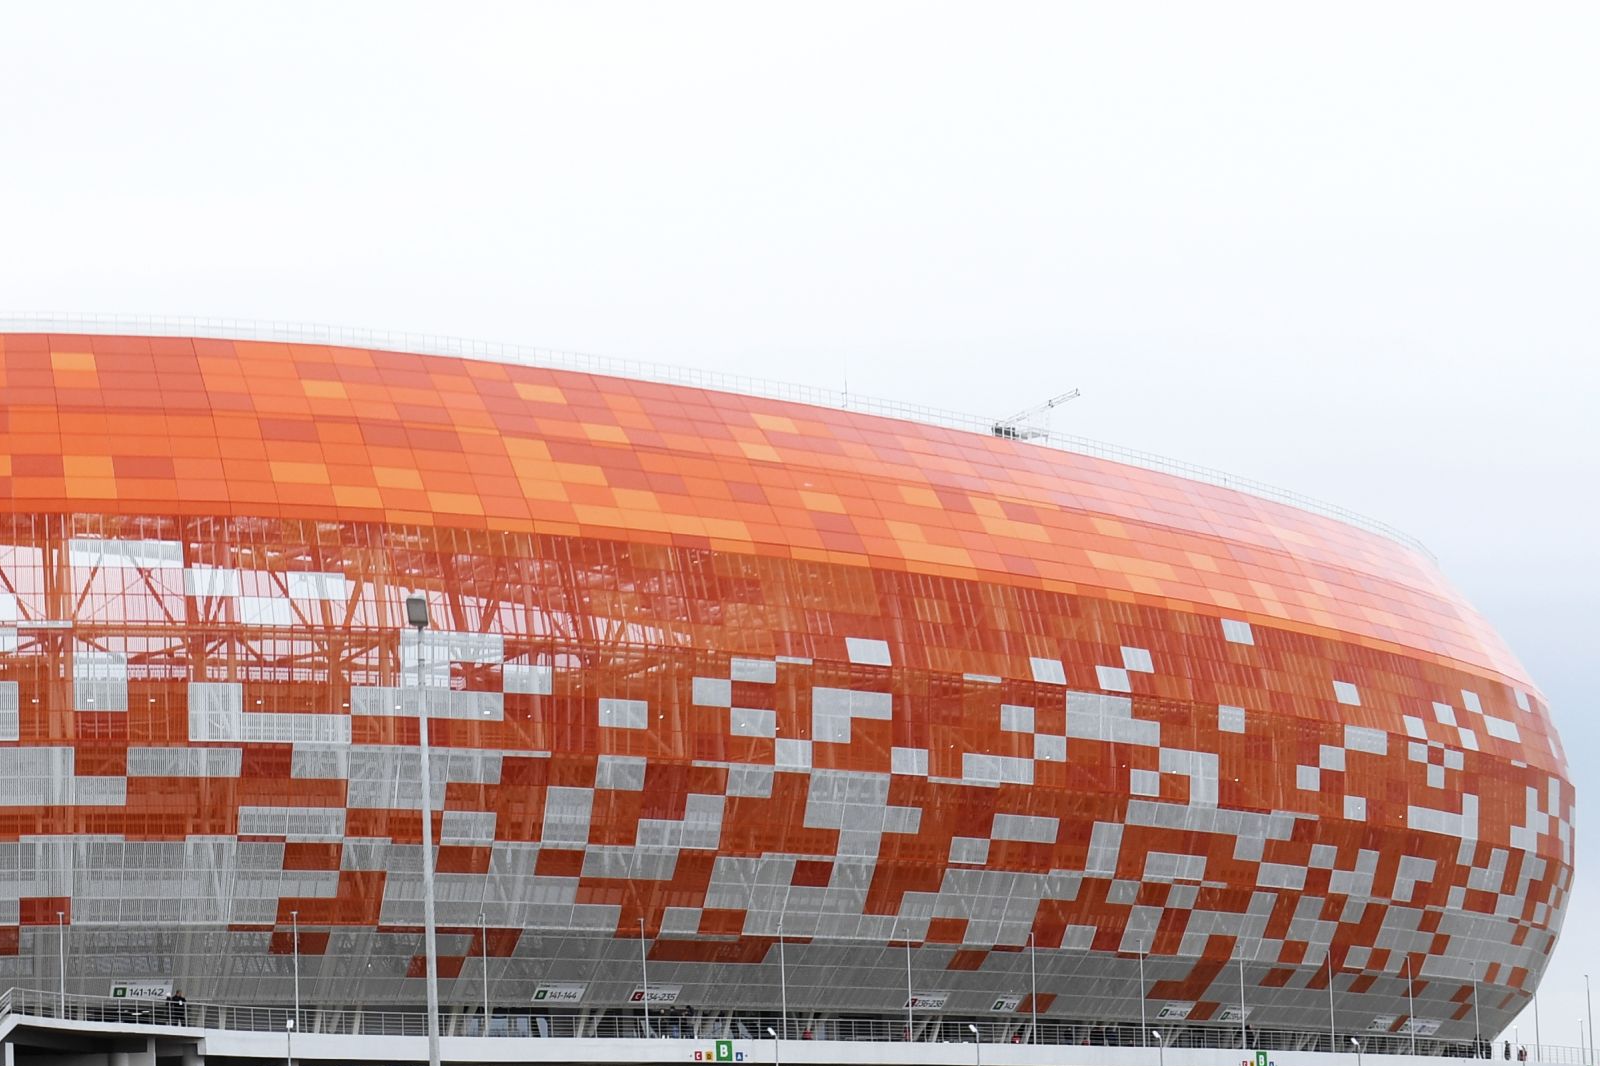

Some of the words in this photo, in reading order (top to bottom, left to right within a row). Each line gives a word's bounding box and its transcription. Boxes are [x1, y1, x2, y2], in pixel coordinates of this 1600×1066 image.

[129, 988, 164, 997] 141-142
[549, 991, 577, 999] 141-144
[720, 1044, 728, 1058] B
